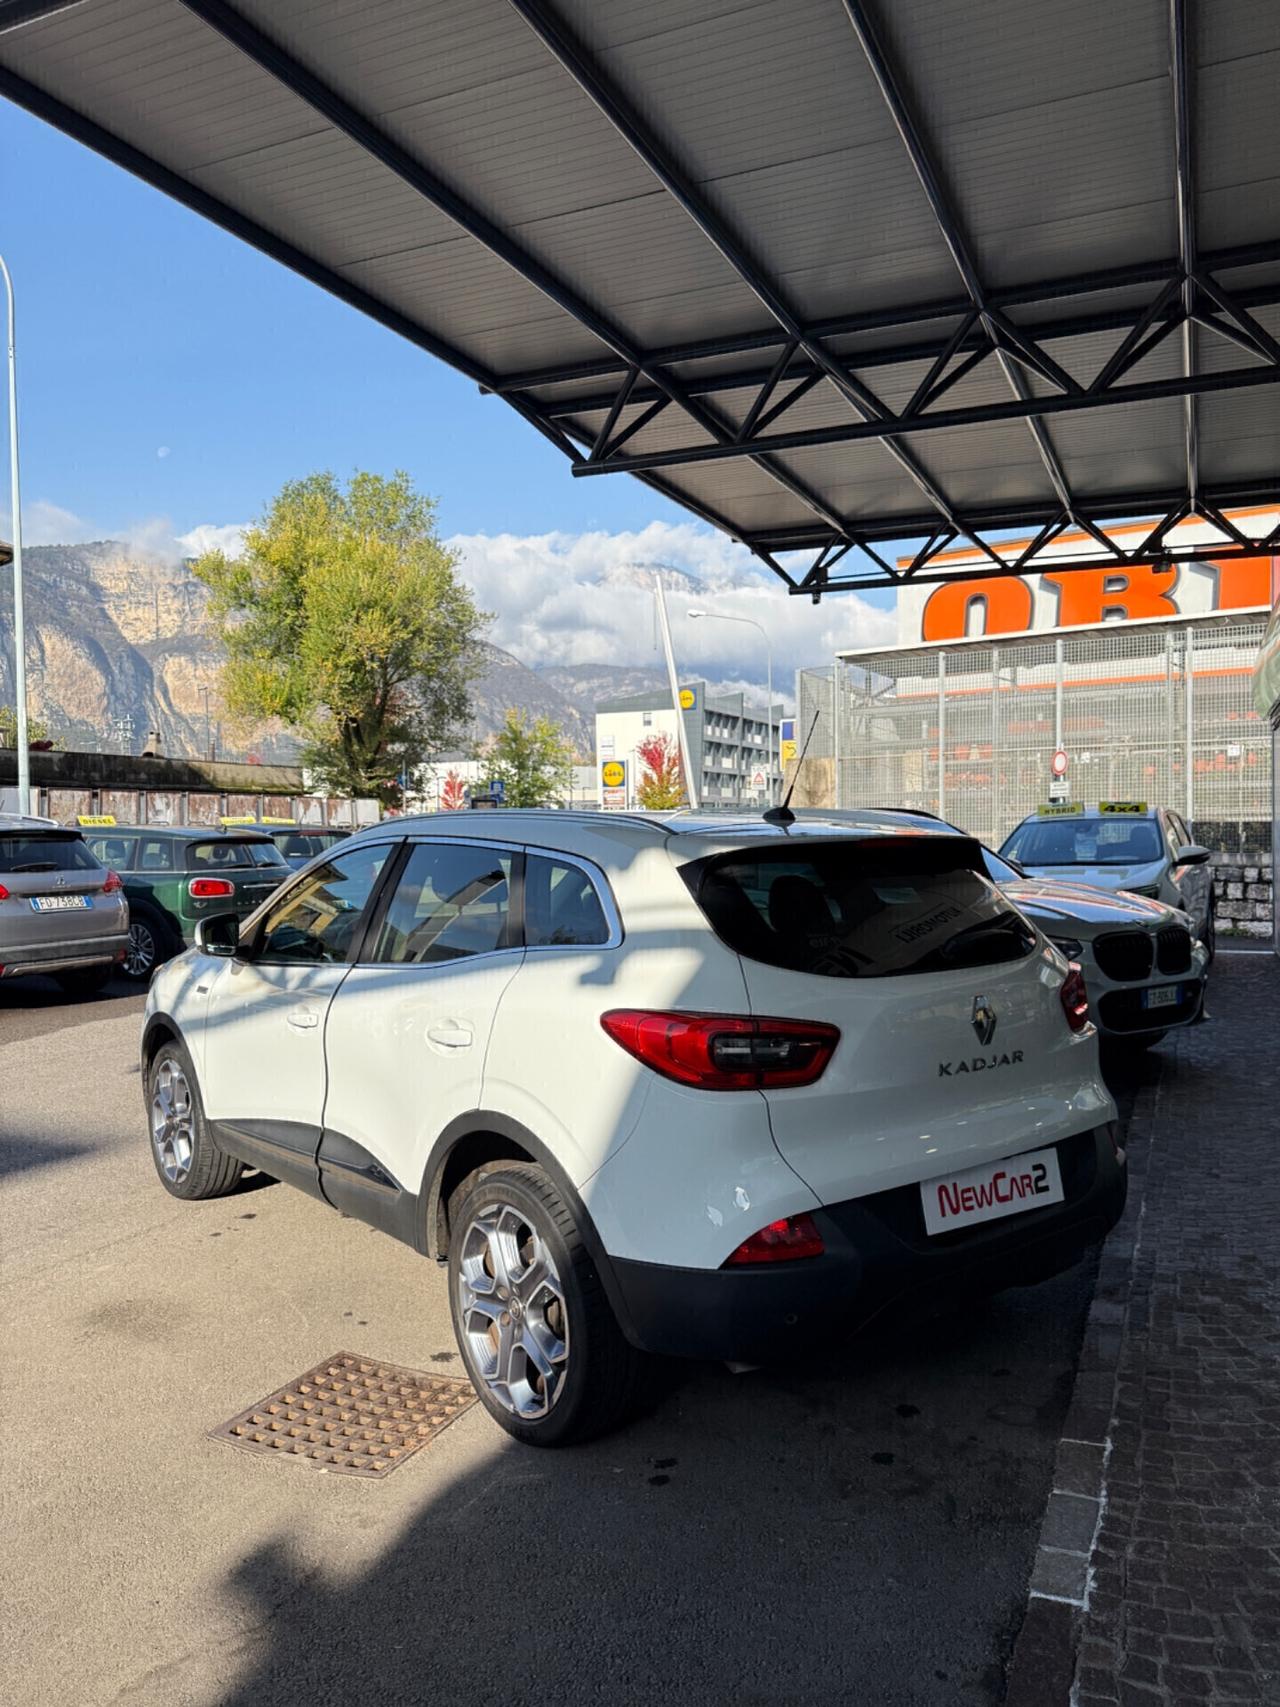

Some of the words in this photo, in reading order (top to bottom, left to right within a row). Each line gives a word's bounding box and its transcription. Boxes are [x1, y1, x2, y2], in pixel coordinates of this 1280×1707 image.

[922, 545, 1280, 642] OBI
[1044, 806, 1076, 815] HYBRID
[938, 1050, 1024, 1077] KADJAR
